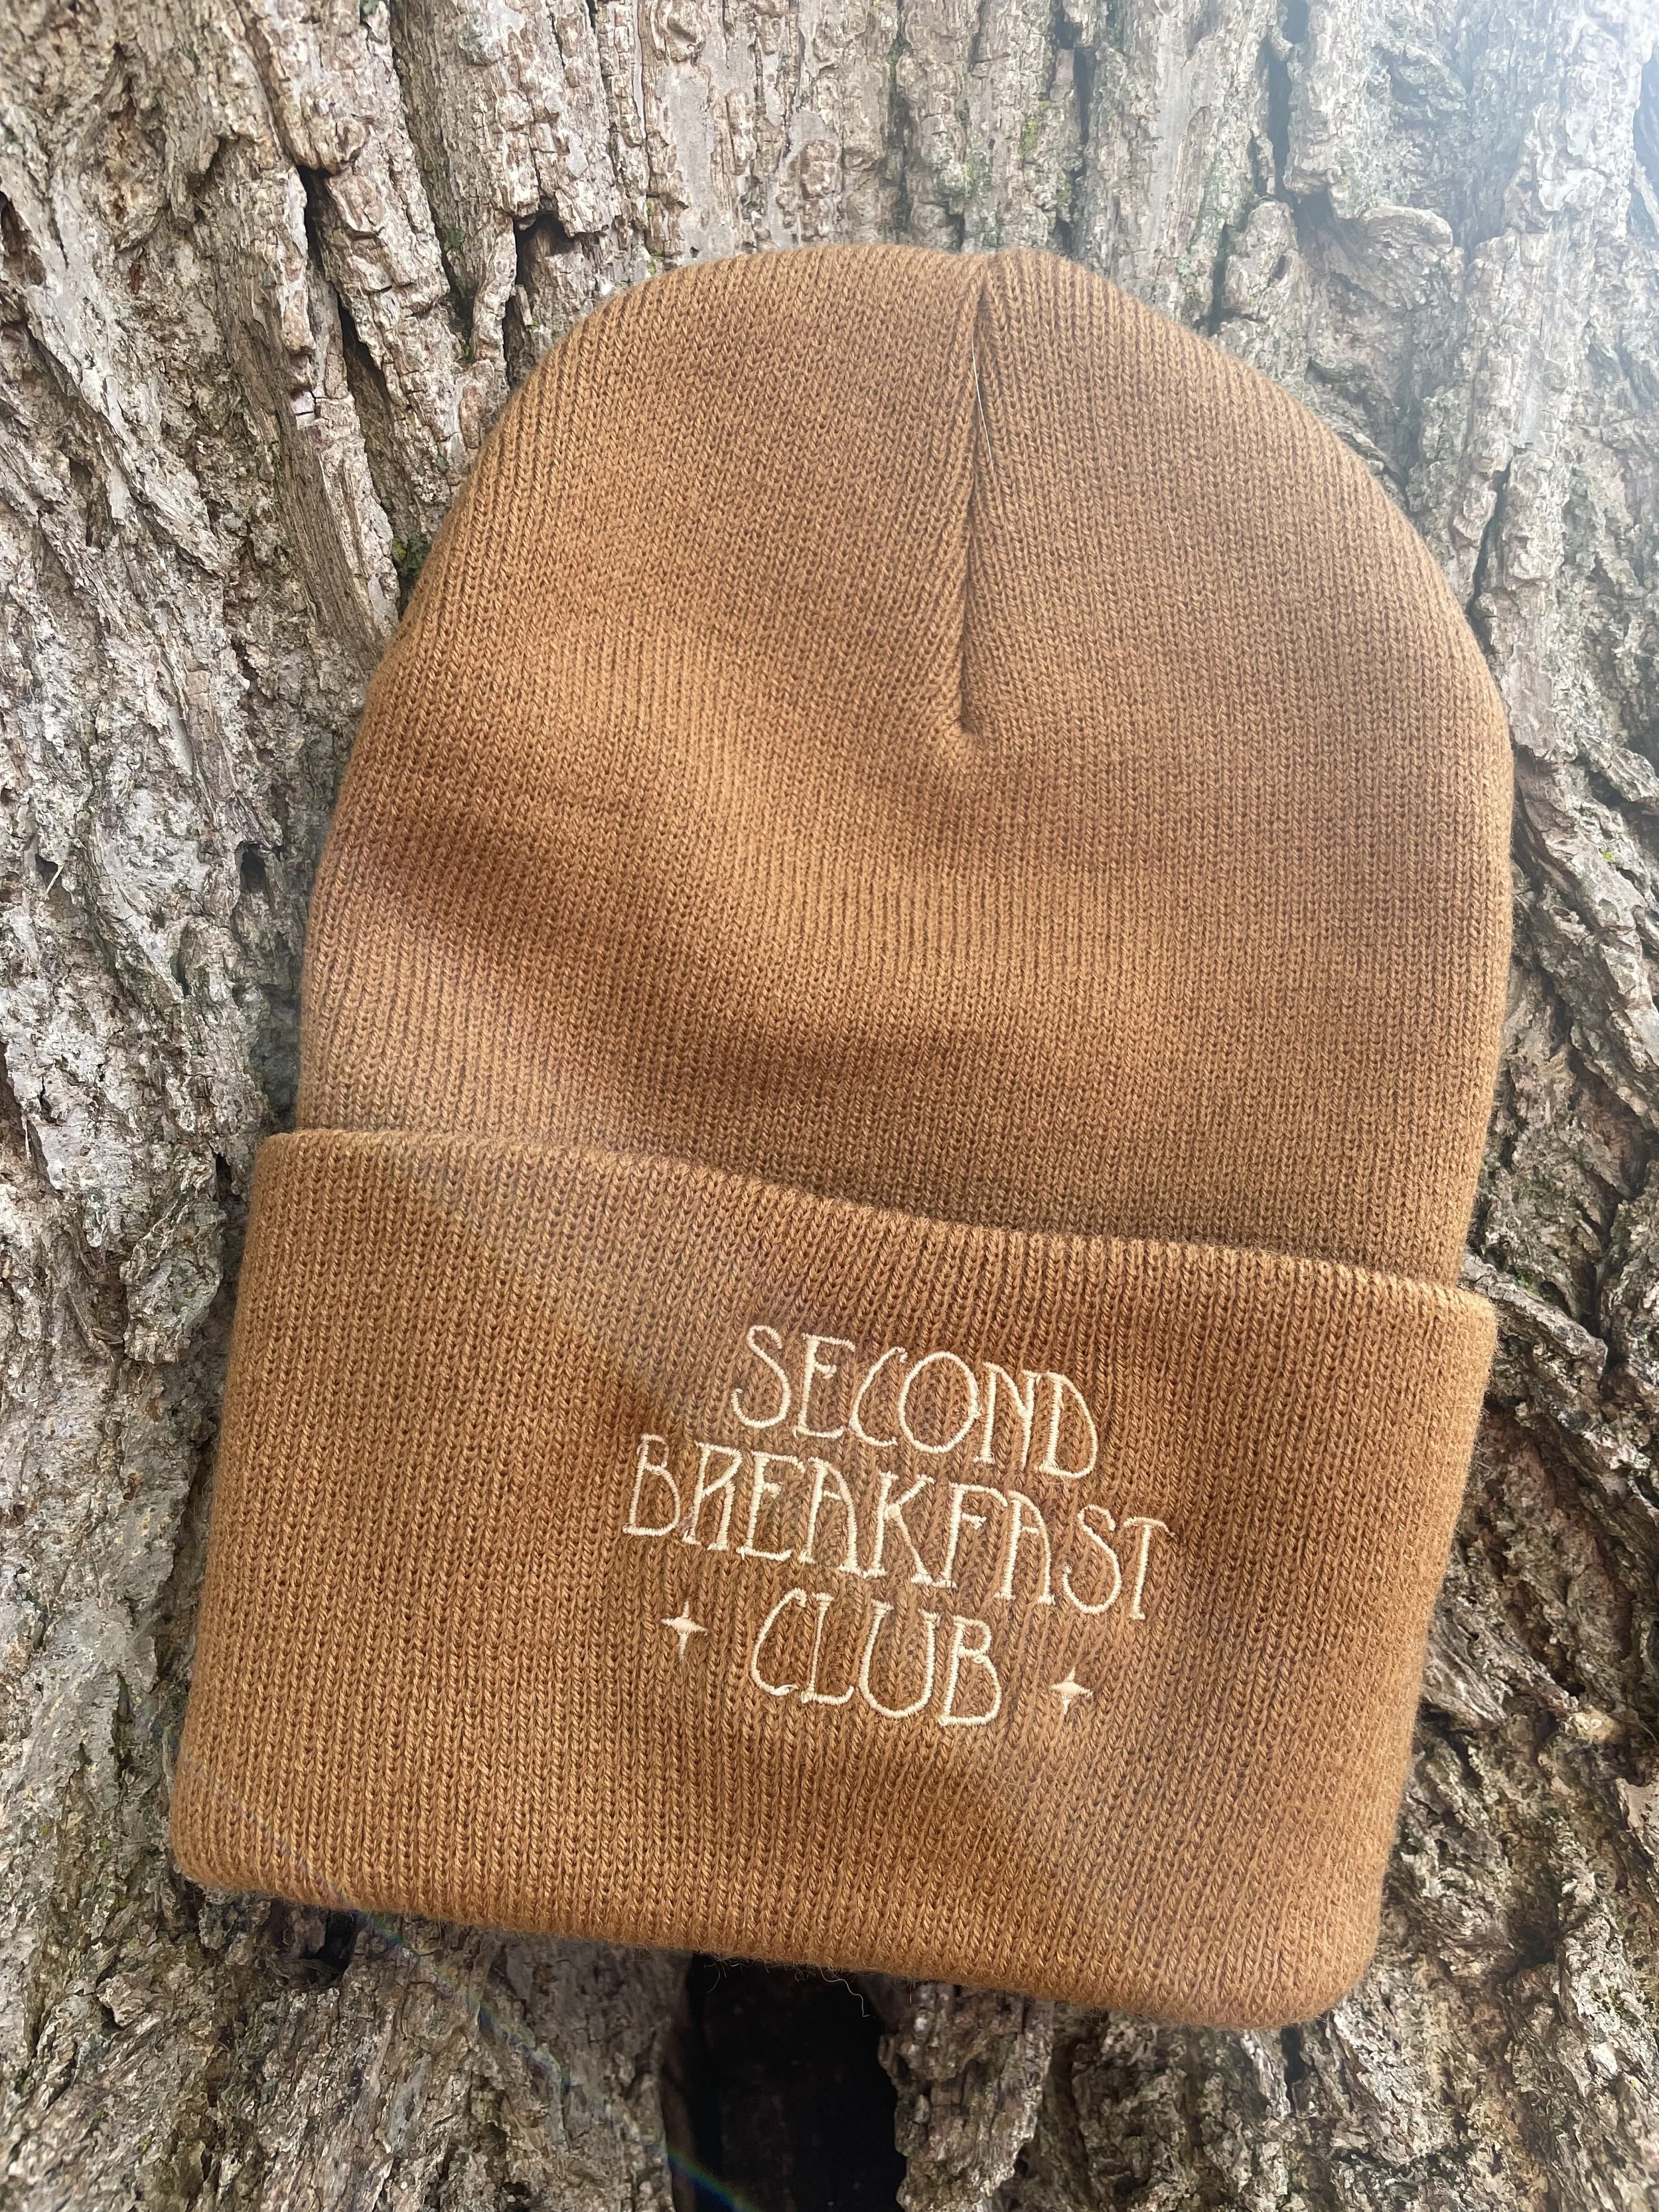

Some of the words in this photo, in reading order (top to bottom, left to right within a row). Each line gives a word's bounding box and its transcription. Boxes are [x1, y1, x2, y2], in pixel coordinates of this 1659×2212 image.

[731, 1324, 1098, 1479] SECOND
[622, 1434, 1172, 1620] BREAKFAST
[751, 1587, 1003, 1727] CLUB
